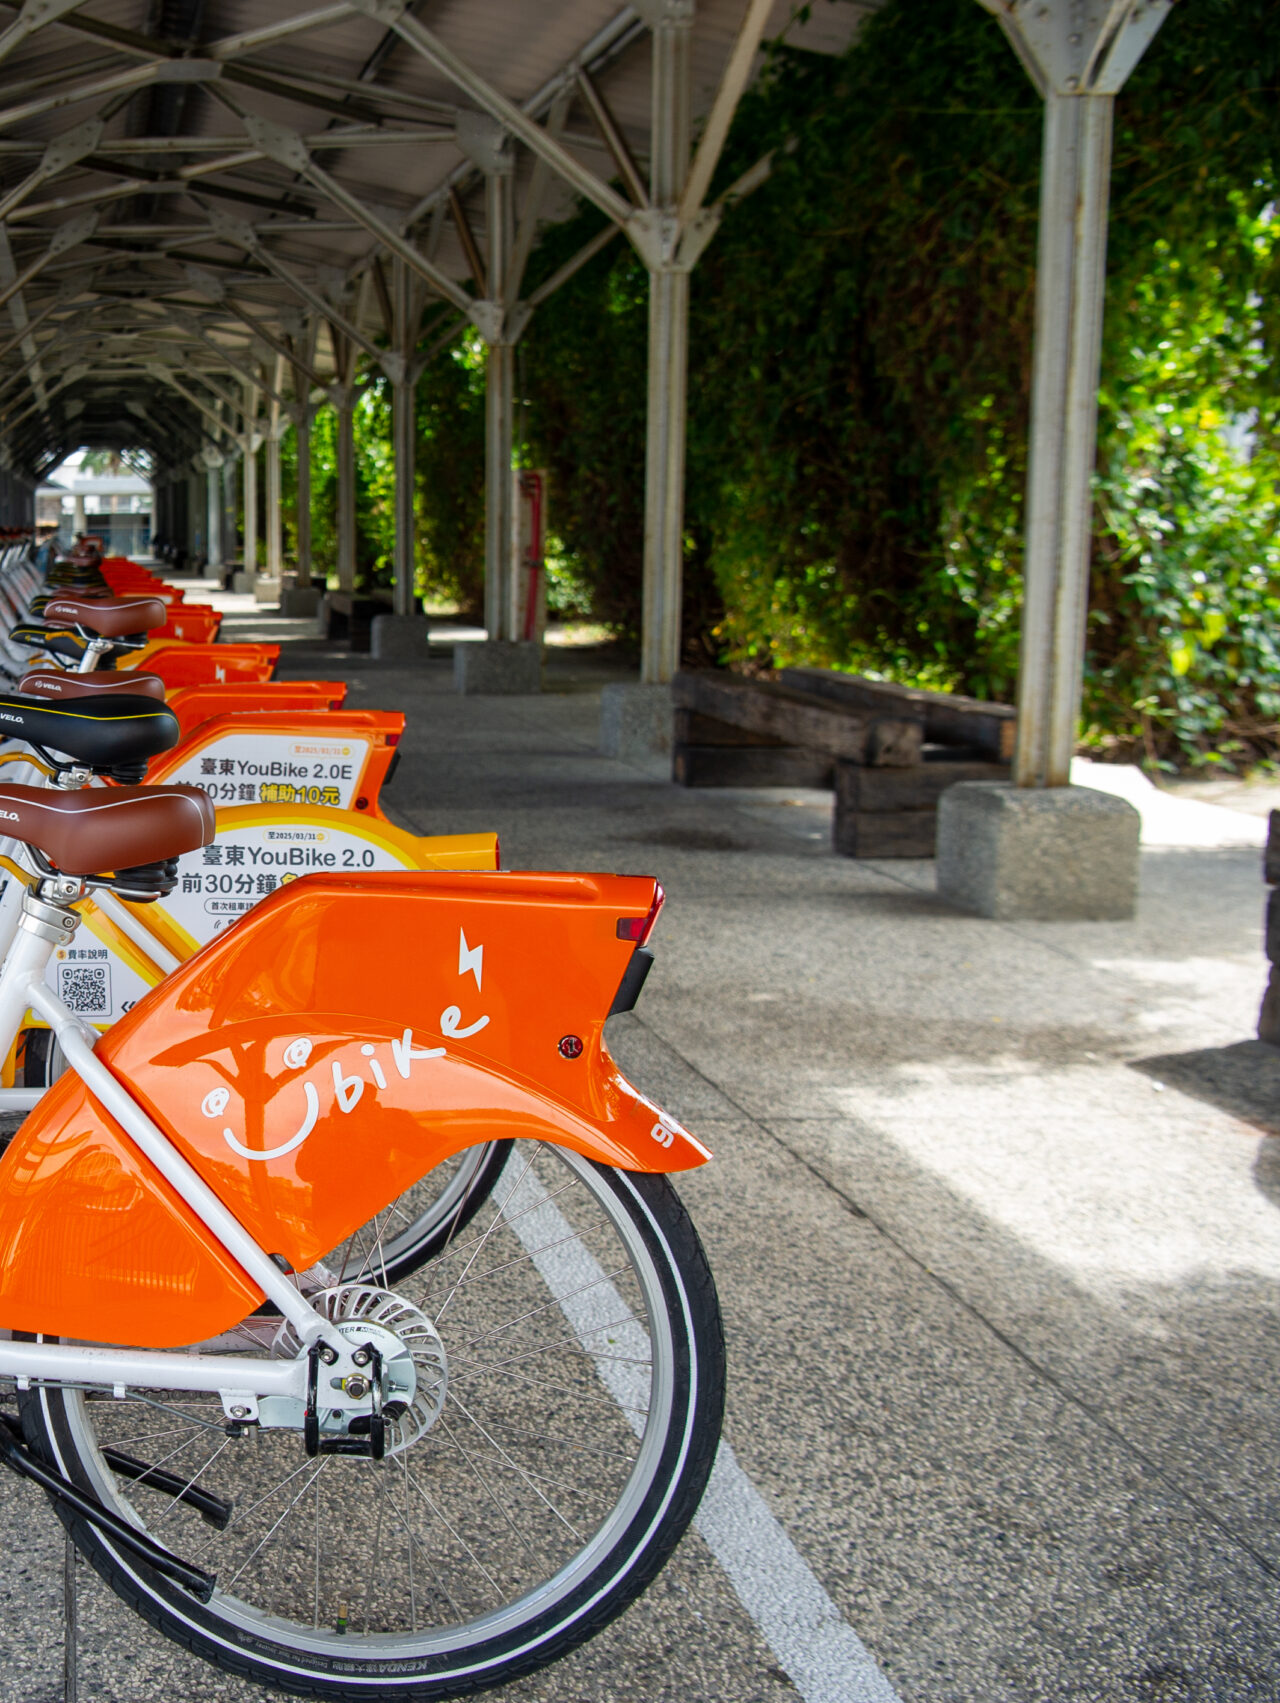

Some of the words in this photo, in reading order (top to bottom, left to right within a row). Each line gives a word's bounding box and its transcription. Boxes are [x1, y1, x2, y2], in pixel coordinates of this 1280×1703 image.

[0, 712, 23, 723] VELO
[313, 763, 353, 780] 2.0E
[202, 845, 336, 867] 臺東YouBike
[341, 849, 375, 867] 2.0
